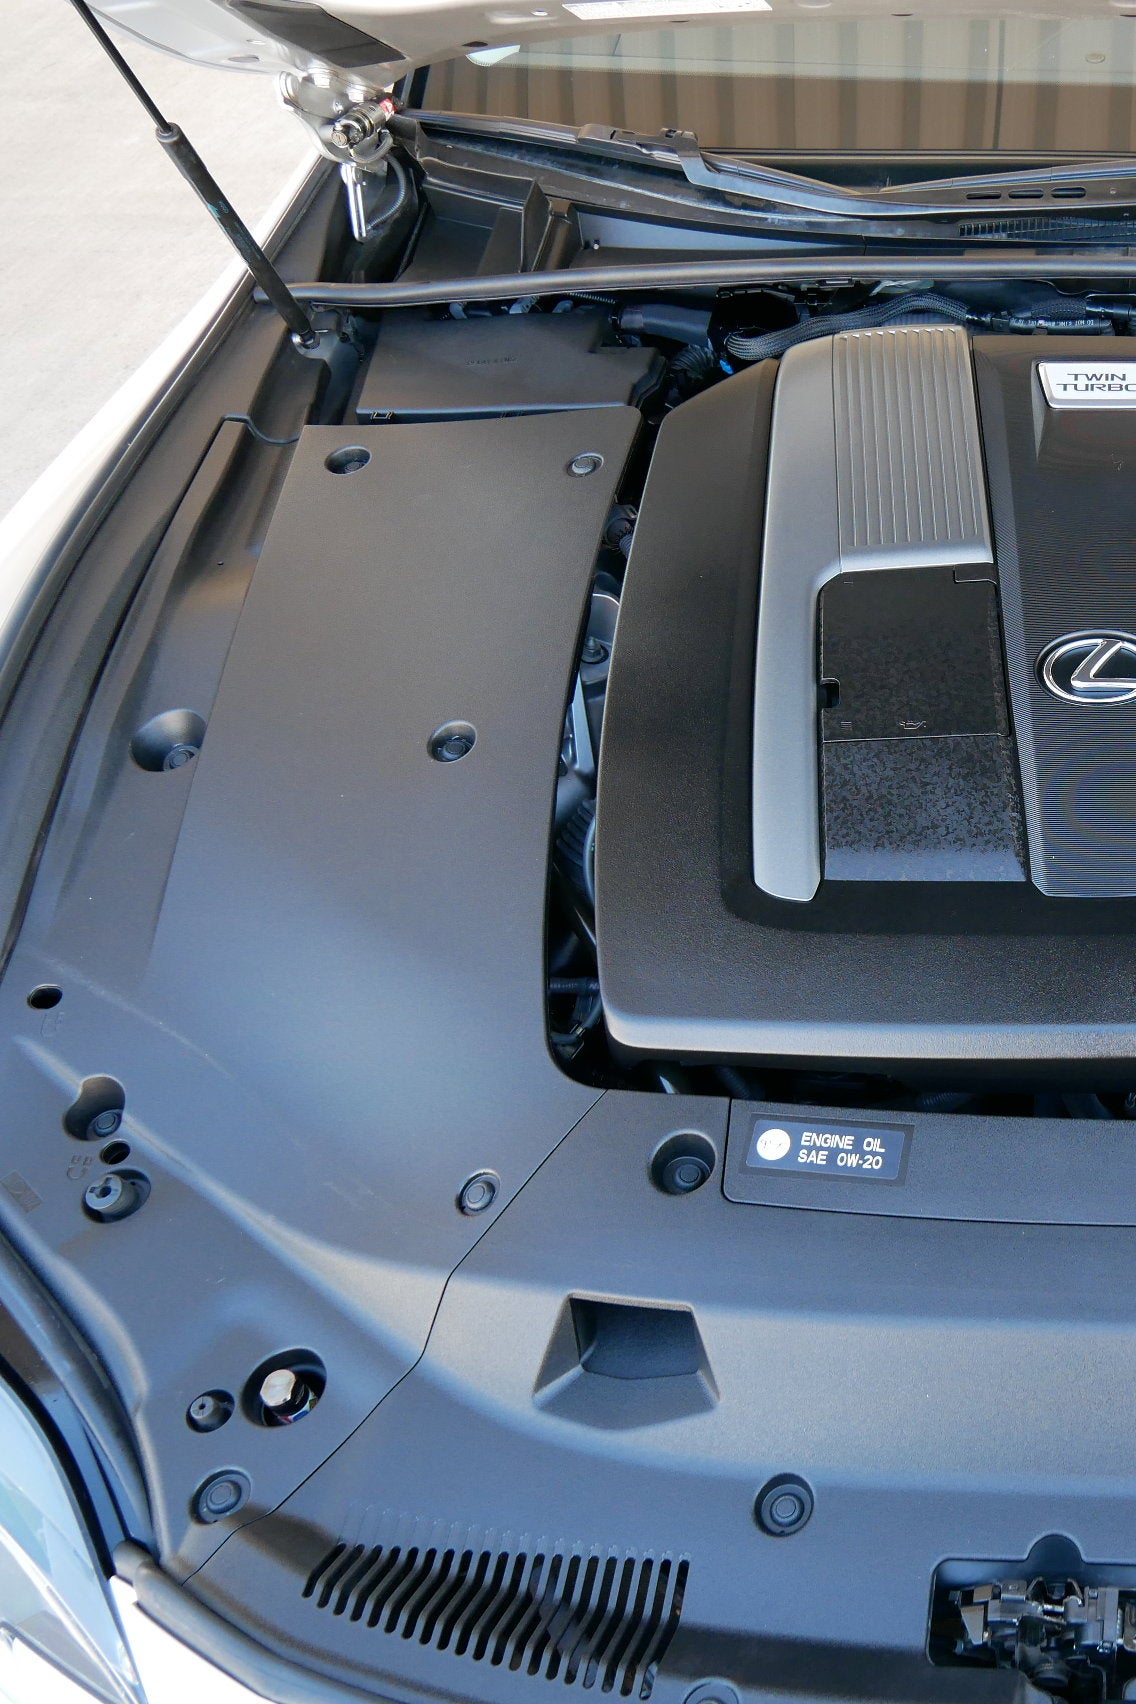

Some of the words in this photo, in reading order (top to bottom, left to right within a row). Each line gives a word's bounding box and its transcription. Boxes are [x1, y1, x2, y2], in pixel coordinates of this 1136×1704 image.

[1067, 373, 1126, 381] TWIN
[801, 1132, 854, 1149] ENGINE
[863, 1137, 885, 1152] OIL
[797, 1149, 829, 1165] SAE
[836, 1152, 883, 1170] 0W-20
